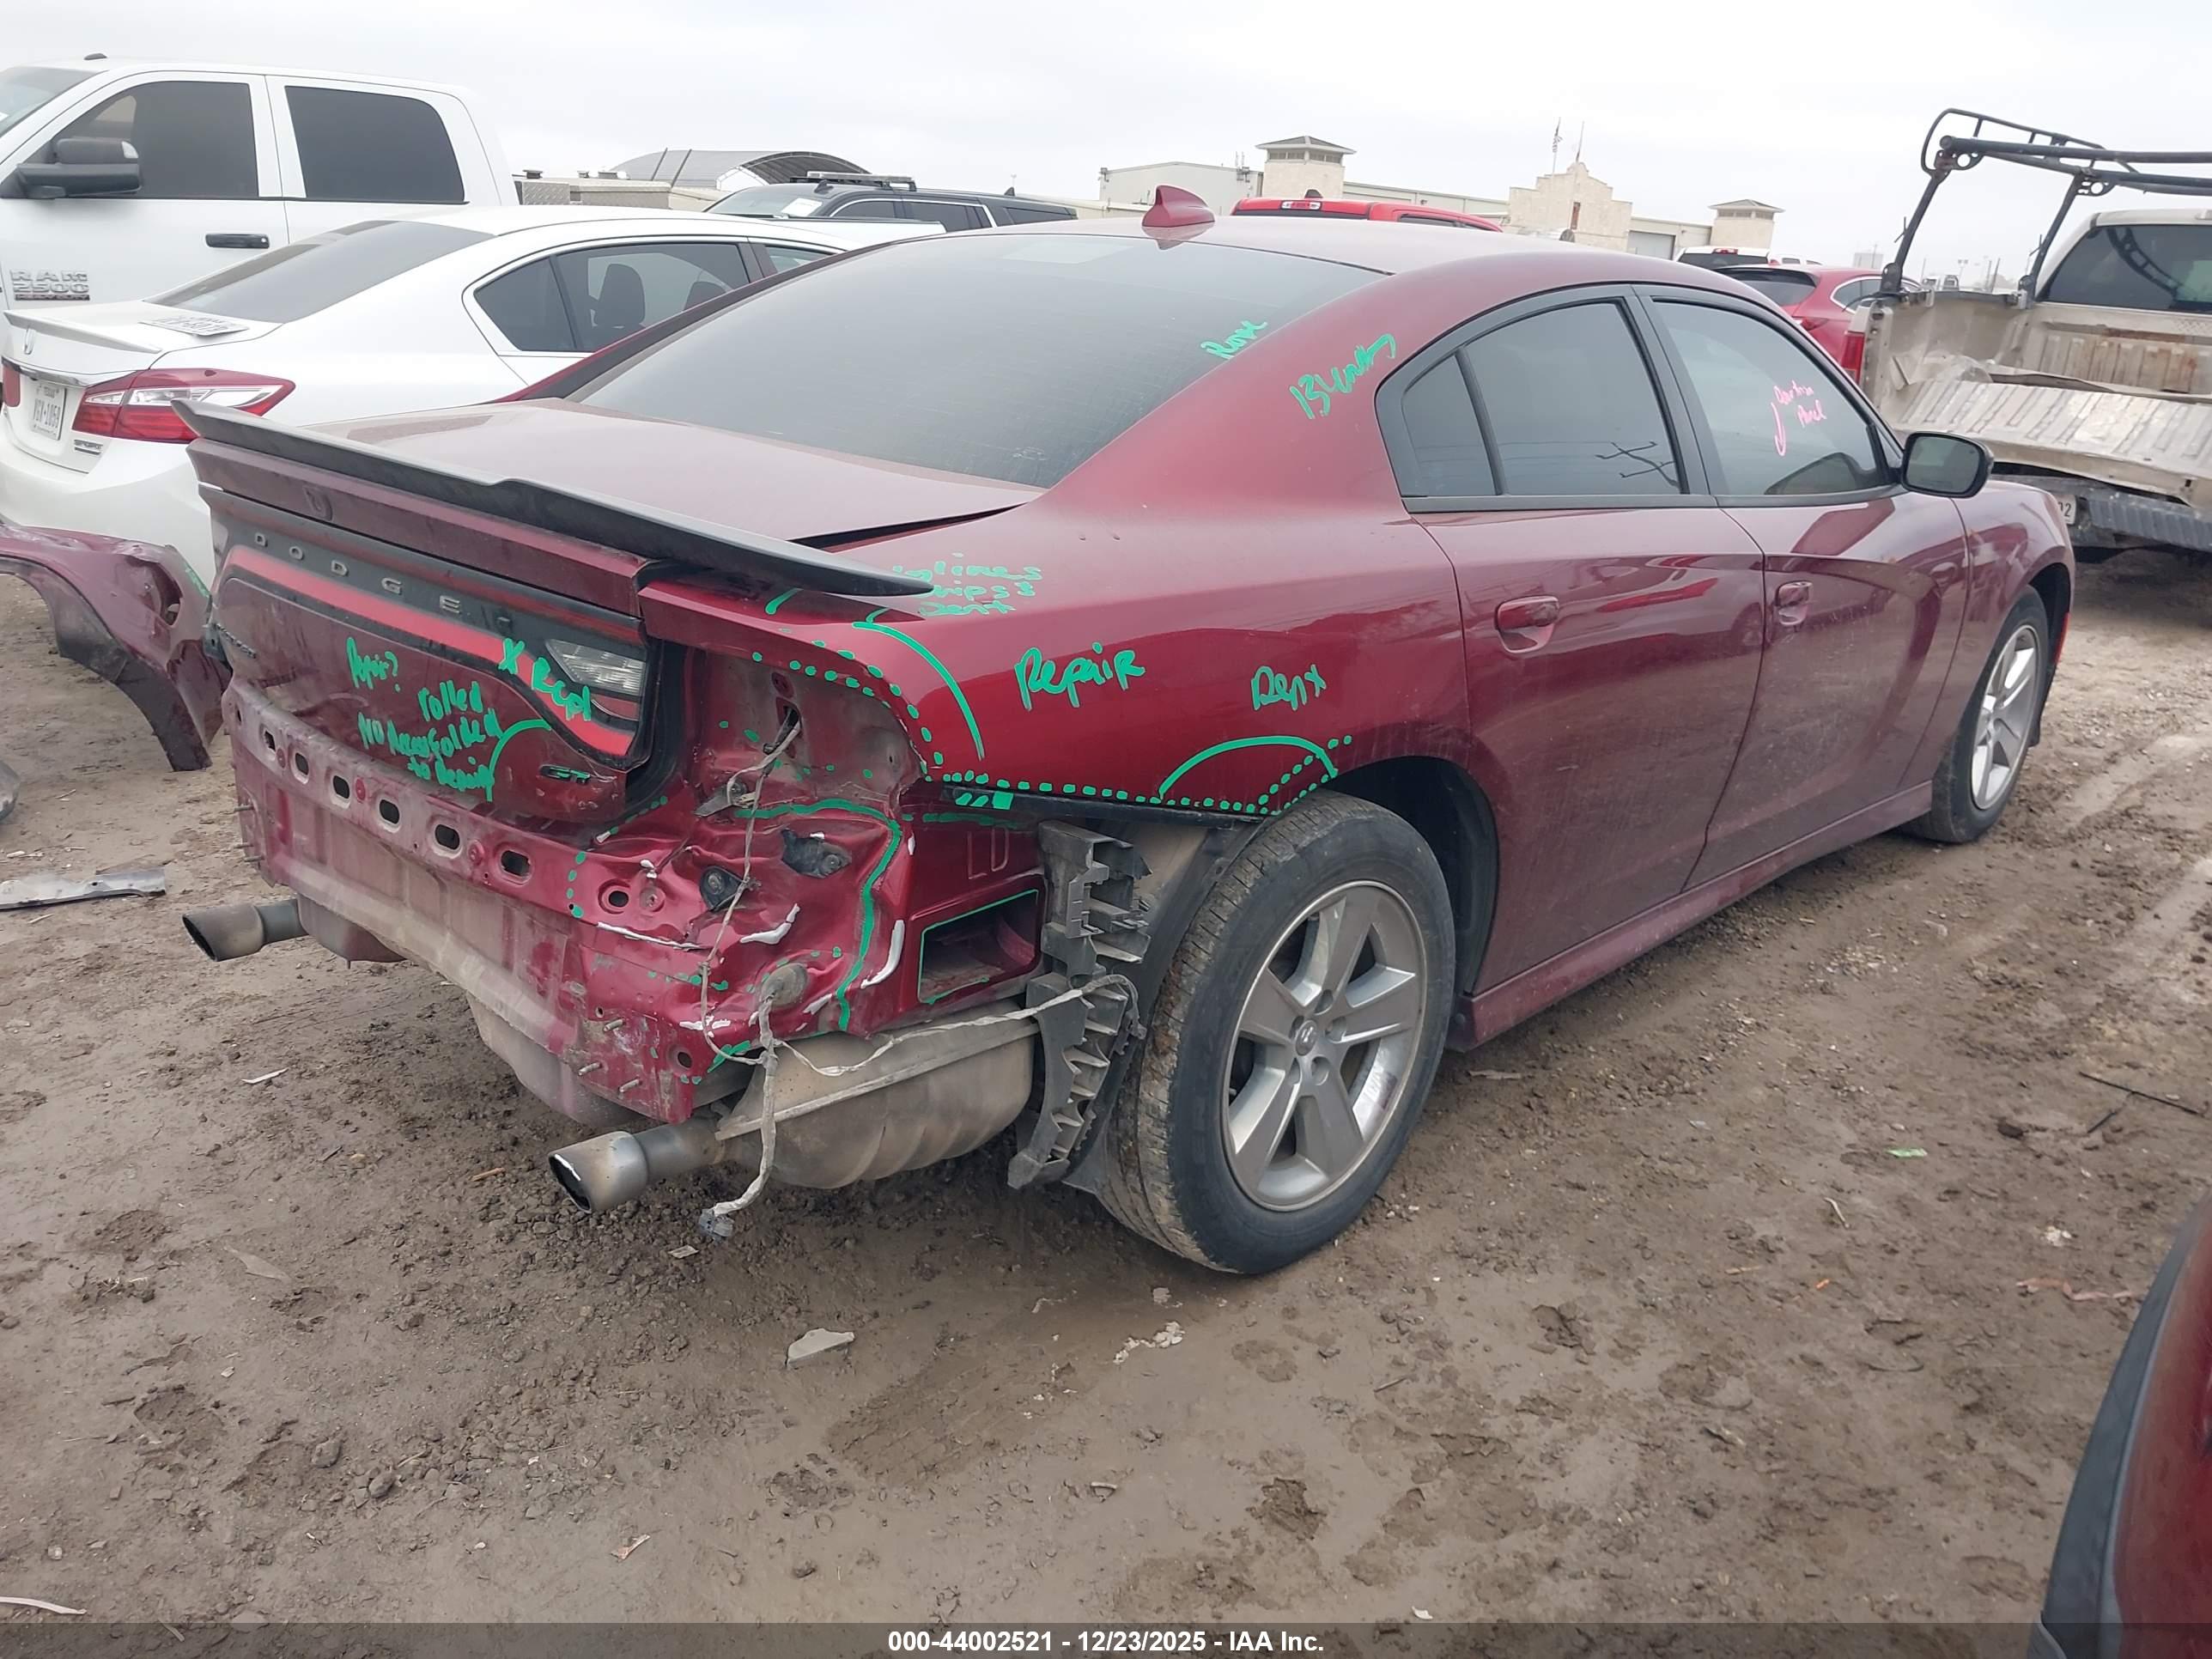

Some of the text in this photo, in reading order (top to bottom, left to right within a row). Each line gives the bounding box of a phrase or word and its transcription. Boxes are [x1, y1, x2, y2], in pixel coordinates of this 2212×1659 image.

[10, 270, 88, 283] RAM
[13, 282, 89, 293] 2500
[255, 532, 462, 615] DODGE
[1014, 641, 1145, 711] Repair
